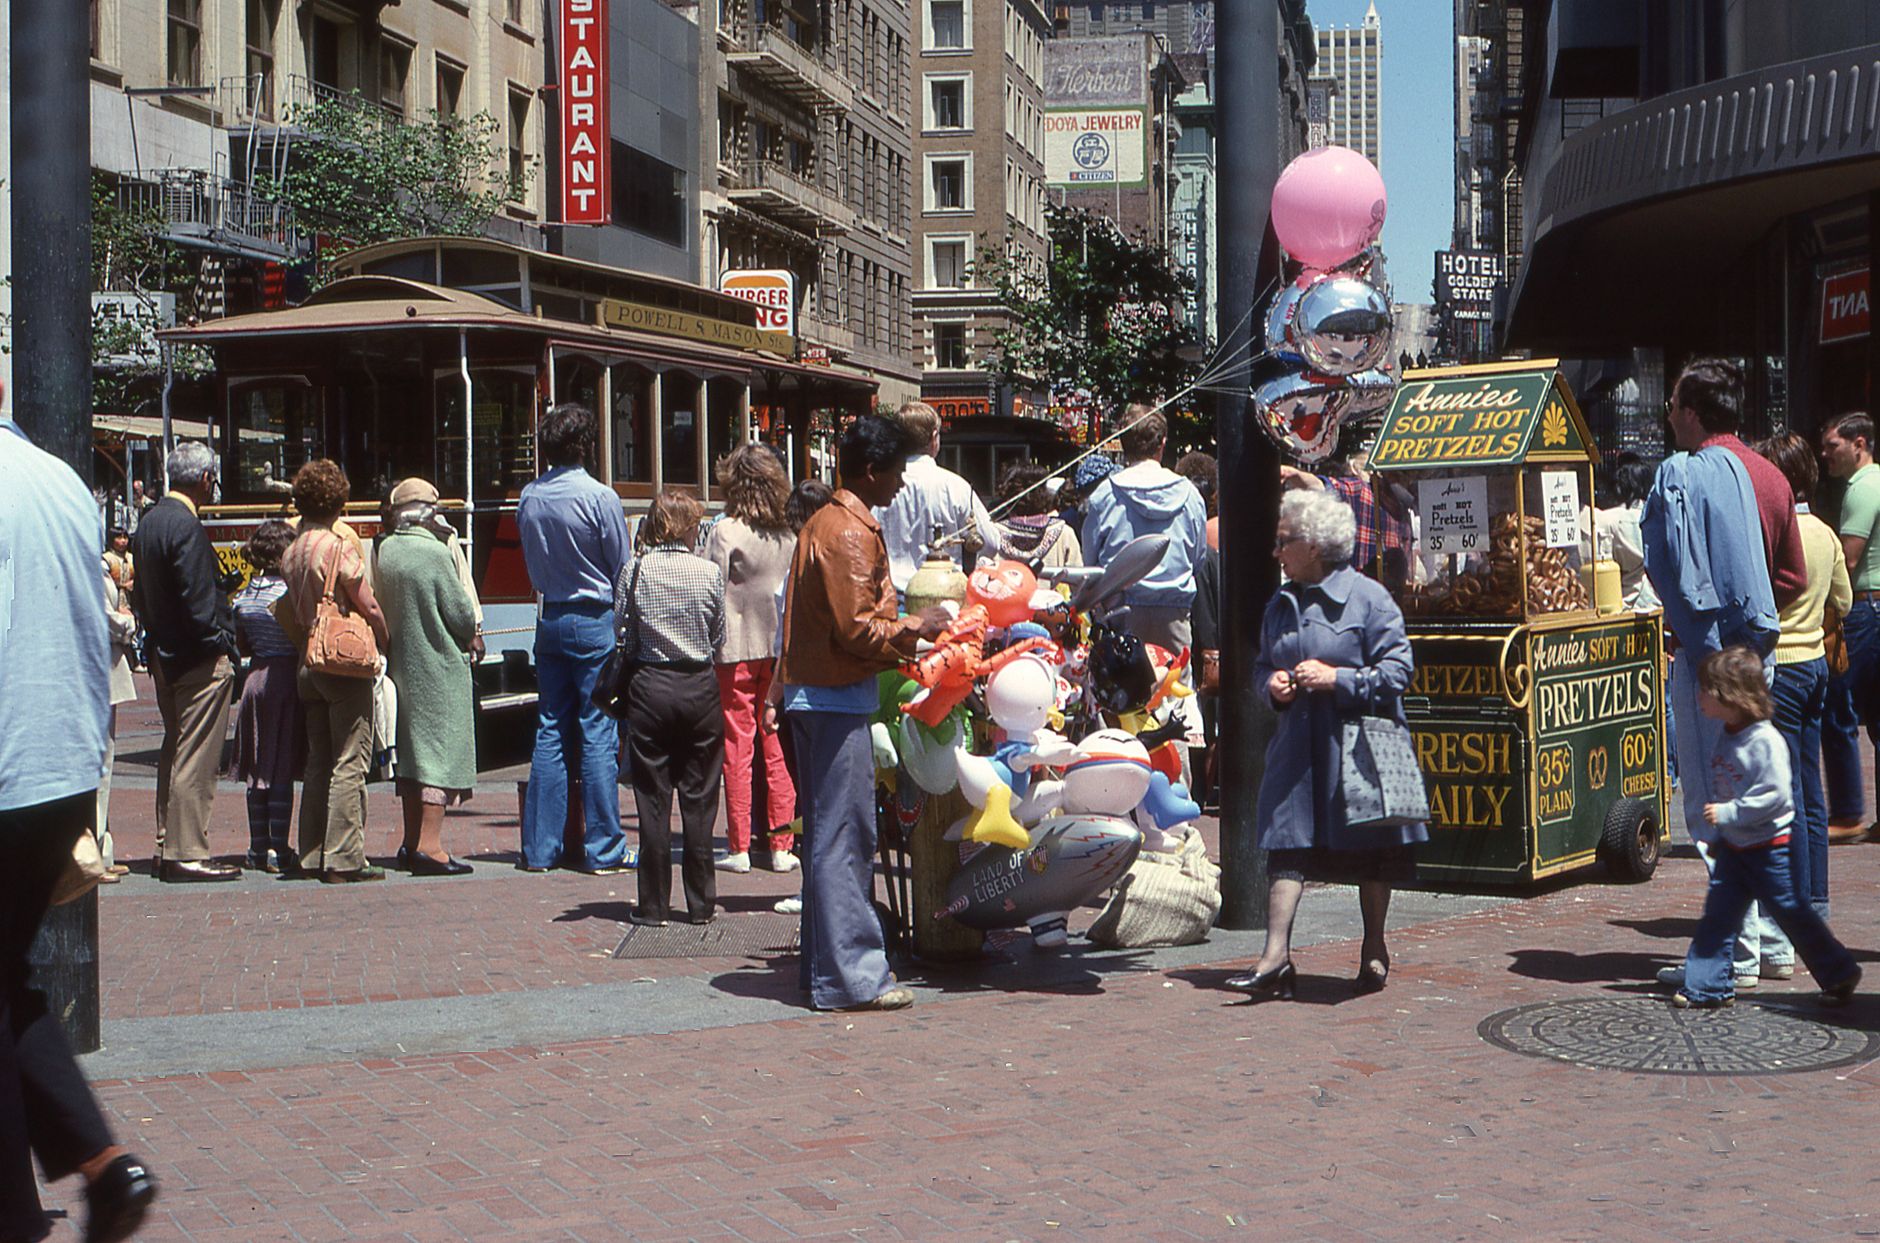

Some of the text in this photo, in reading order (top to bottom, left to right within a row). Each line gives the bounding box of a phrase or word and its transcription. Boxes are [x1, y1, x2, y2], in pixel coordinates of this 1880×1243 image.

[1081, 115, 1141, 131] JEWELRY
[1078, 171, 1114, 181] CITIZEN
[1442, 254, 1502, 276] HOTEL
[1448, 274, 1497, 288] GOLDEN
[1452, 287, 1493, 301] STATE
[618, 305, 689, 332] POWELL
[695, 320, 705, 334] &
[711, 323, 763, 346] MASON
[1405, 383, 1523, 413] Annies
[1391, 408, 1531, 436] SOFT HOT
[1375, 432, 1523, 463] PRETZELS
[1431, 509, 1474, 526] Pretzels
[1455, 500, 1473, 510] HOT
[1534, 632, 1651, 672] Annies SOFT HOT
[1404, 664, 1521, 696] RETZELS
[1539, 667, 1652, 731] PRETZELS
[1623, 732, 1654, 769] 60¢
[1539, 746, 1571, 788] 35¢
[1623, 770, 1656, 795] CHEESE
[1430, 783, 1513, 827] AILY
[1539, 788, 1573, 817] PLAIN
[972, 850, 1025, 888] LAND OF
[974, 867, 1026, 904] LIBERTY
